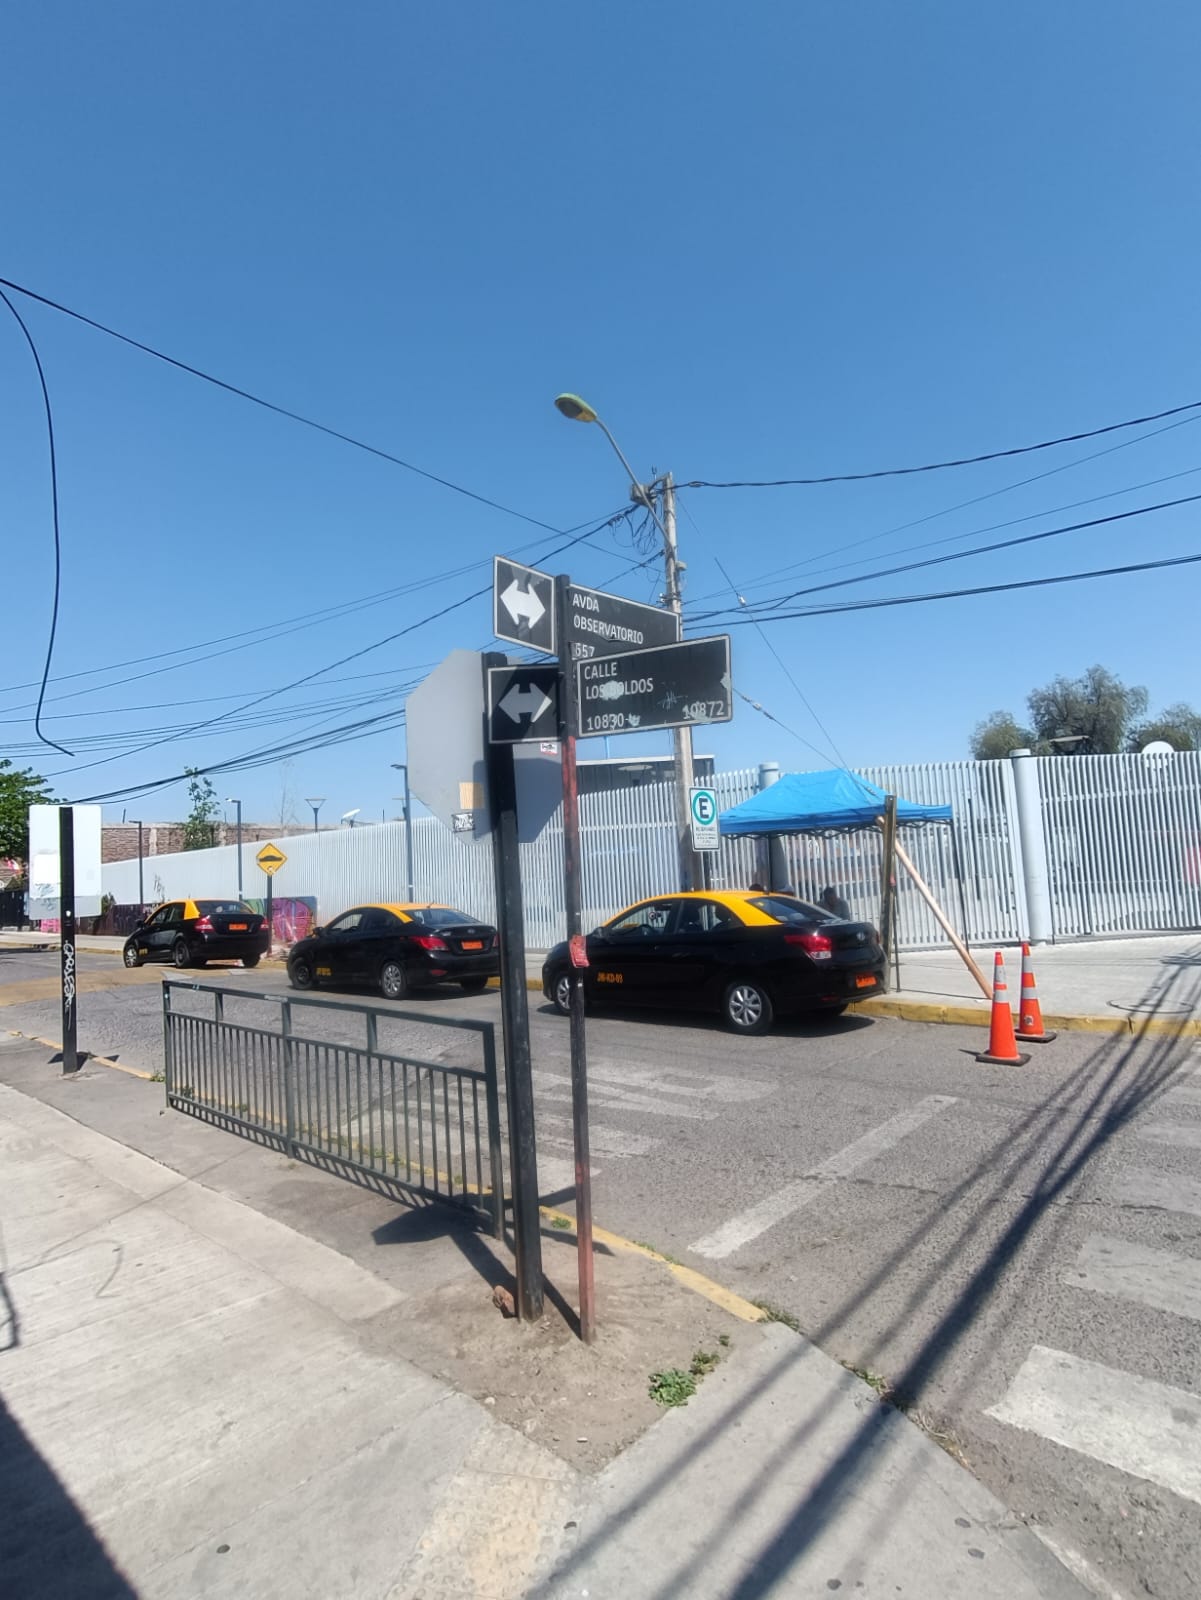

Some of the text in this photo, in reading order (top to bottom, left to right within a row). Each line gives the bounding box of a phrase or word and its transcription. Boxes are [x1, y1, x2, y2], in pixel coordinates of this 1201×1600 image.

[573, 593, 600, 613] AVDA
[573, 614, 644, 645] OBSERVATORIO
[584, 662, 618, 680] CALLE
[698, 797, 710, 819] E
